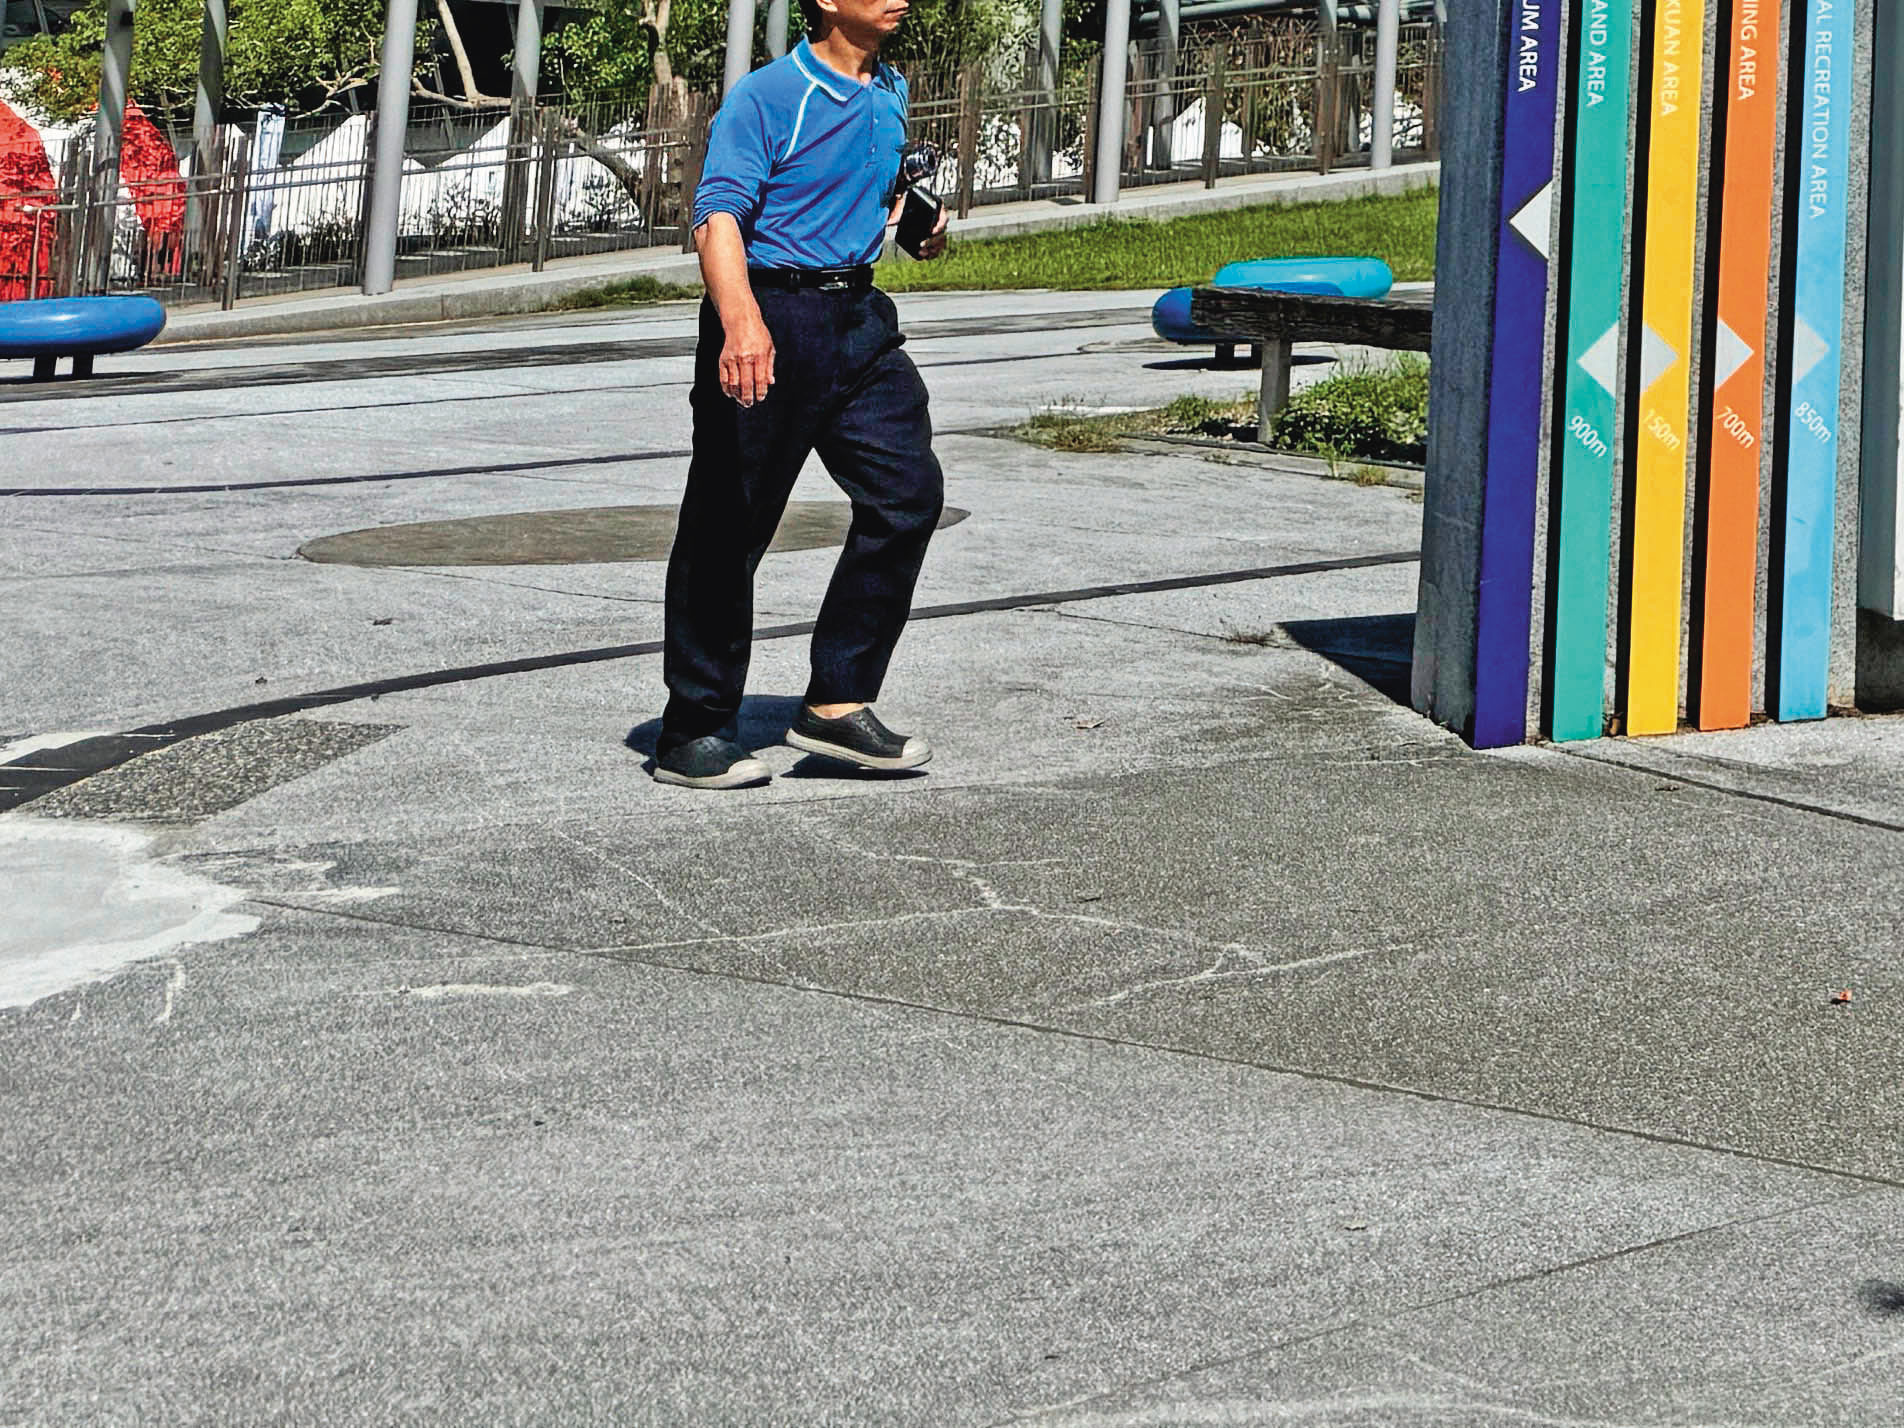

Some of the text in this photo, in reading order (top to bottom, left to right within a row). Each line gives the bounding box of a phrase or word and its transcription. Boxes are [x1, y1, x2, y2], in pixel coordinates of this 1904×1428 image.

[1518, 35, 1539, 93] AREA
[1586, 51, 1606, 107] AREA
[1661, 61, 1681, 117] AREA
[1738, 45, 1757, 101] AREA
[1812, 30, 1833, 159] RECREATION
[1809, 165, 1828, 220] AREA
[1568, 415, 1607, 457] 900m
[1643, 407, 1681, 451] 150m
[1716, 405, 1755, 448] 700m
[1795, 401, 1832, 443] 850m
